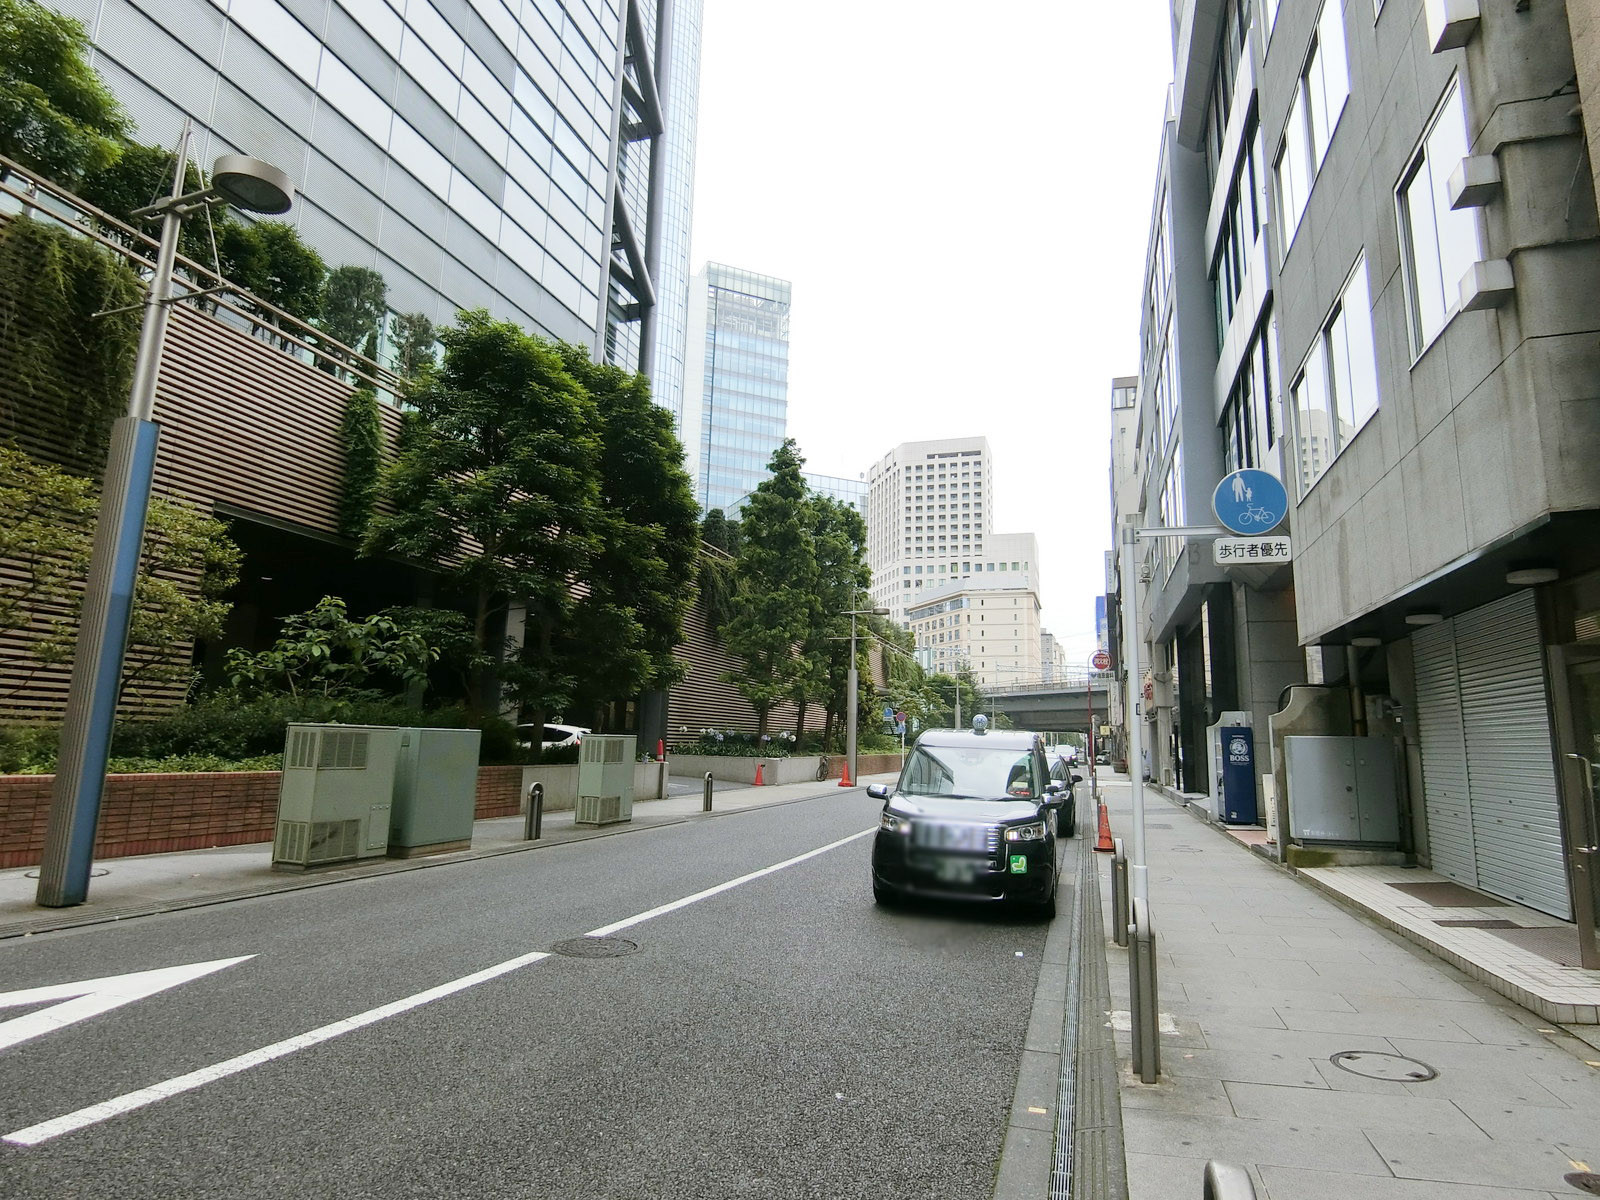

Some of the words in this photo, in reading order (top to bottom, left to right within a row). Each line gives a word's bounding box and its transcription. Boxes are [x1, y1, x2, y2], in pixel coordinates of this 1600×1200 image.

[1219, 543, 1288, 558] 歩行者優先
